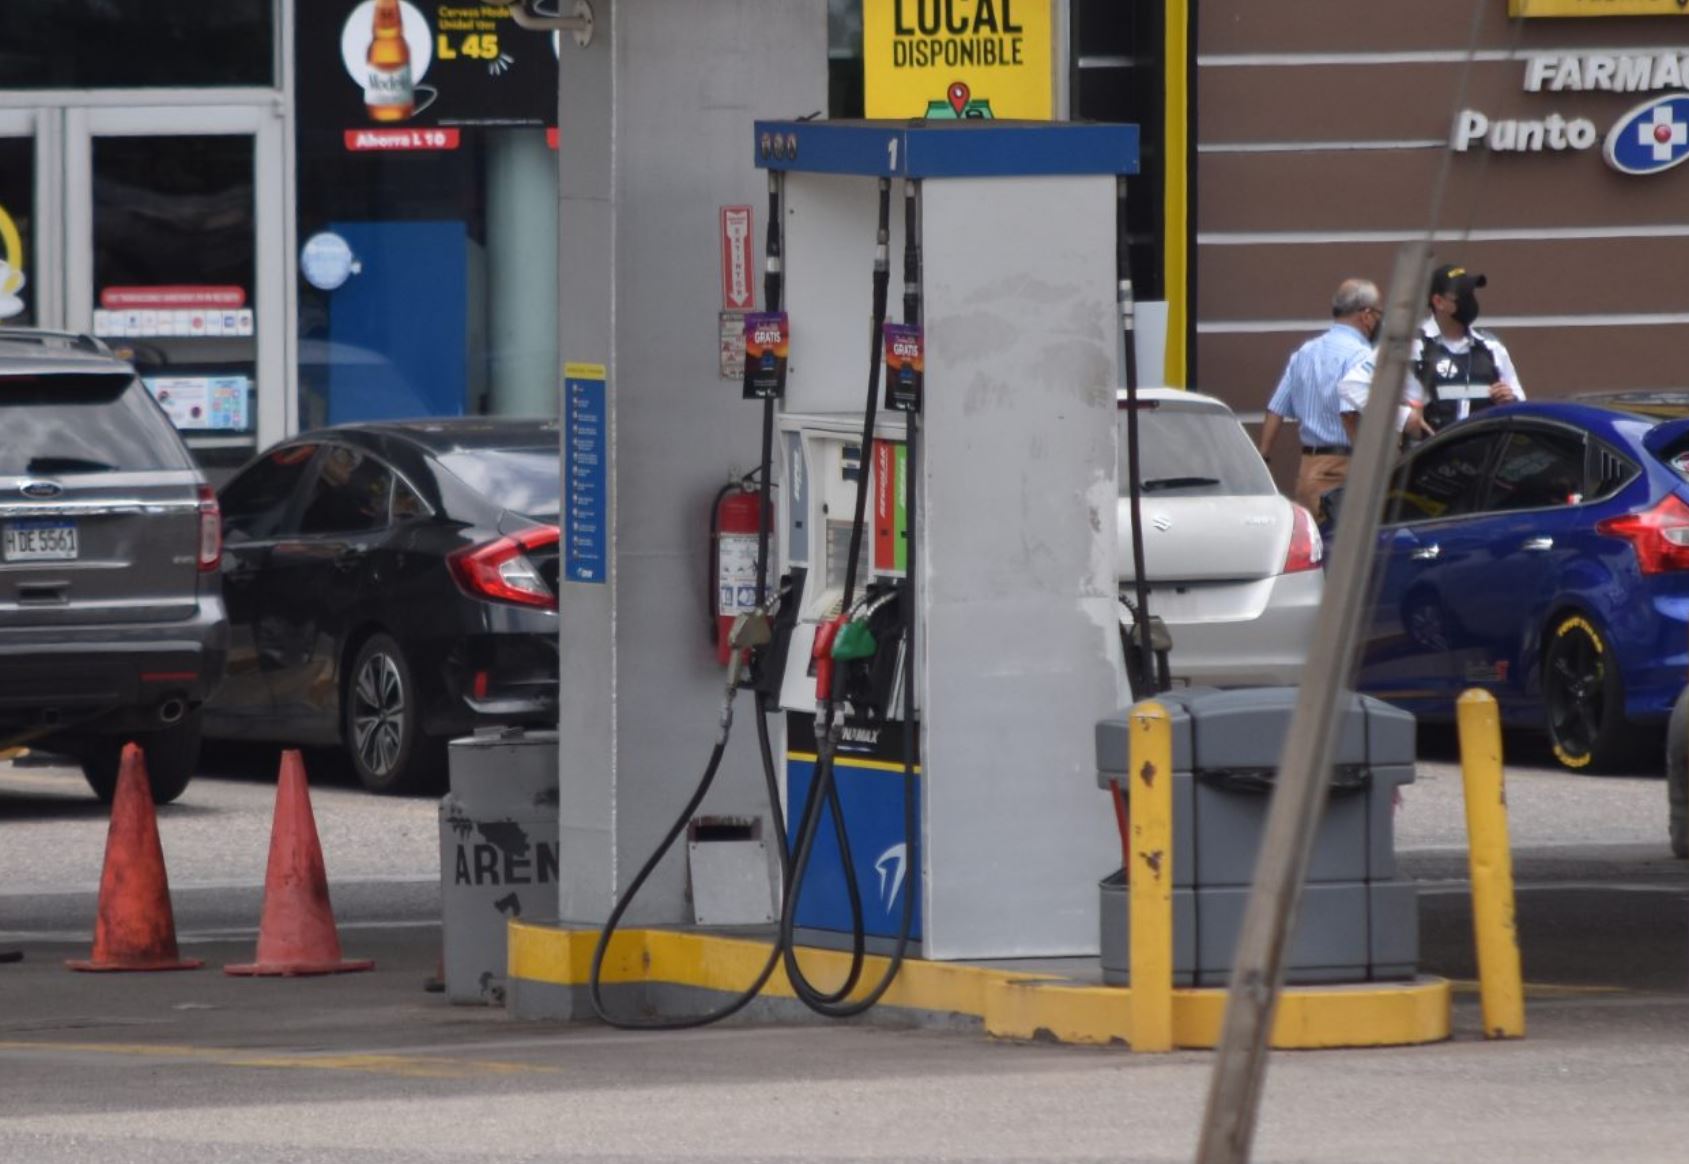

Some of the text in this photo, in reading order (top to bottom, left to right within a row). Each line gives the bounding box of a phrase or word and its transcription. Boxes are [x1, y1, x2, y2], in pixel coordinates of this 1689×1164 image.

[893, 0, 1023, 36] LOCAL
[437, 34, 498, 59] L 45
[893, 37, 1024, 68] DISPONIBLE
[356, 132, 410, 148] Ahorro
[1456, 110, 1596, 151] Punto
[888, 138, 898, 171] 1
[754, 331, 781, 344] GRATIS
[893, 343, 918, 357] GRATIS
[40, 528, 75, 552] 5561
